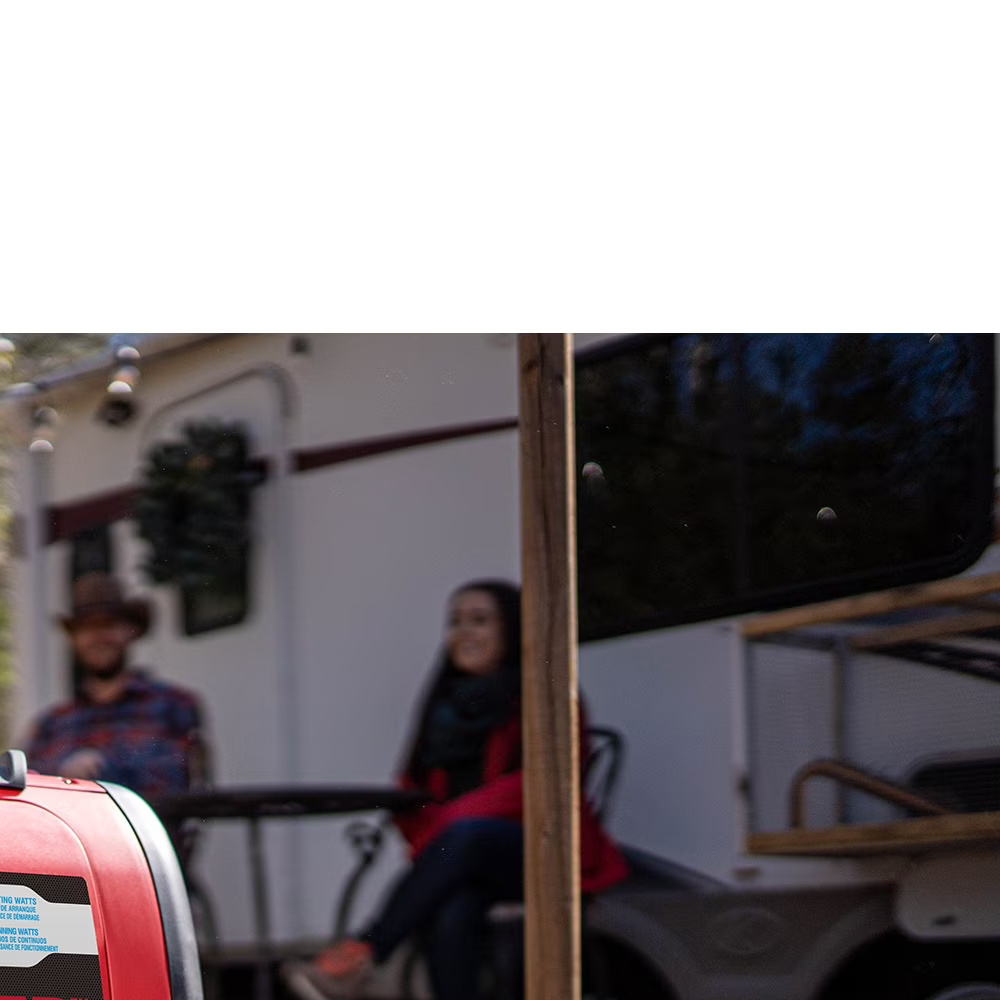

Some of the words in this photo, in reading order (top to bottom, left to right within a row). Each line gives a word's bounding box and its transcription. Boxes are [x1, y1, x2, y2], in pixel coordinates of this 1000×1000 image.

[14, 897, 37, 905] WATTS
[8, 905, 36, 913] ARRANQUE
[18, 928, 39, 936] WATTS
[17, 936, 48, 944] CONTINUOS
